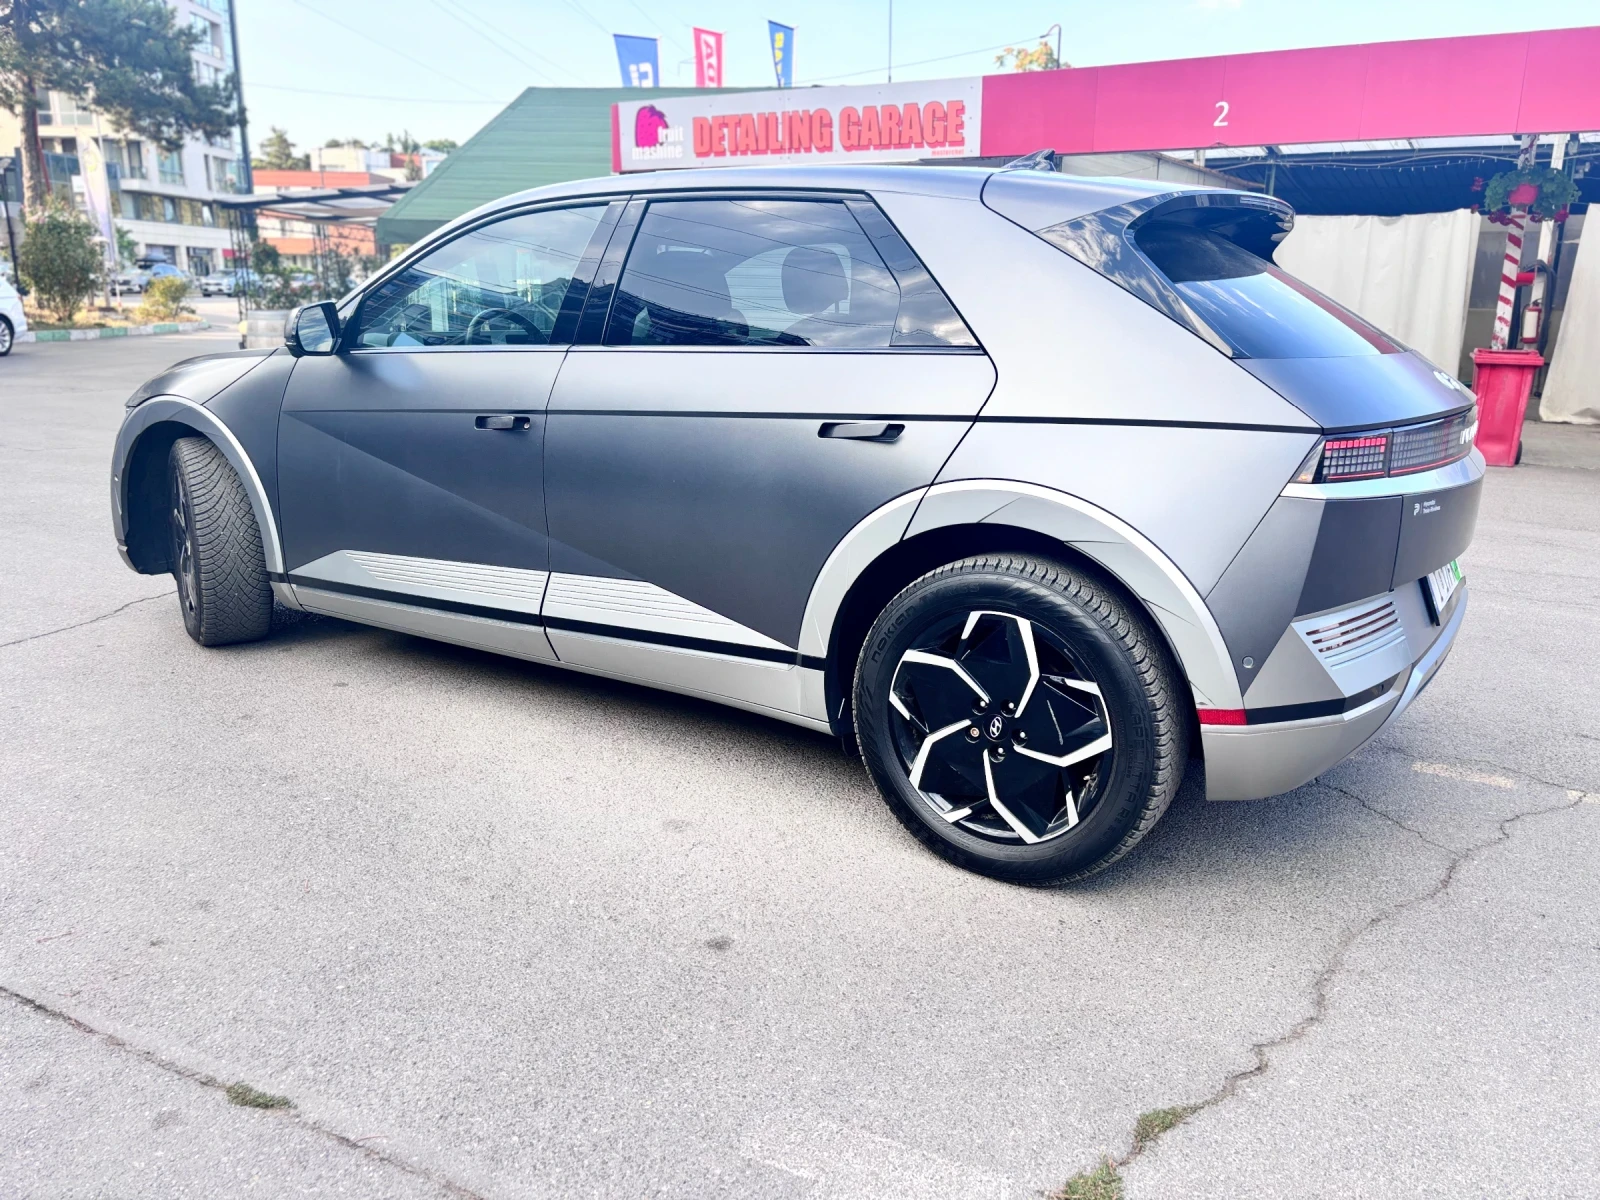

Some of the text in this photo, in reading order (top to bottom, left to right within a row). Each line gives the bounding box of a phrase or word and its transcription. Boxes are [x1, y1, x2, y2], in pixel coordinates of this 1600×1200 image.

[1213, 101, 1229, 127] 2
[657, 125, 684, 143] fruit
[692, 100, 966, 158] DETAILING GARAGE
